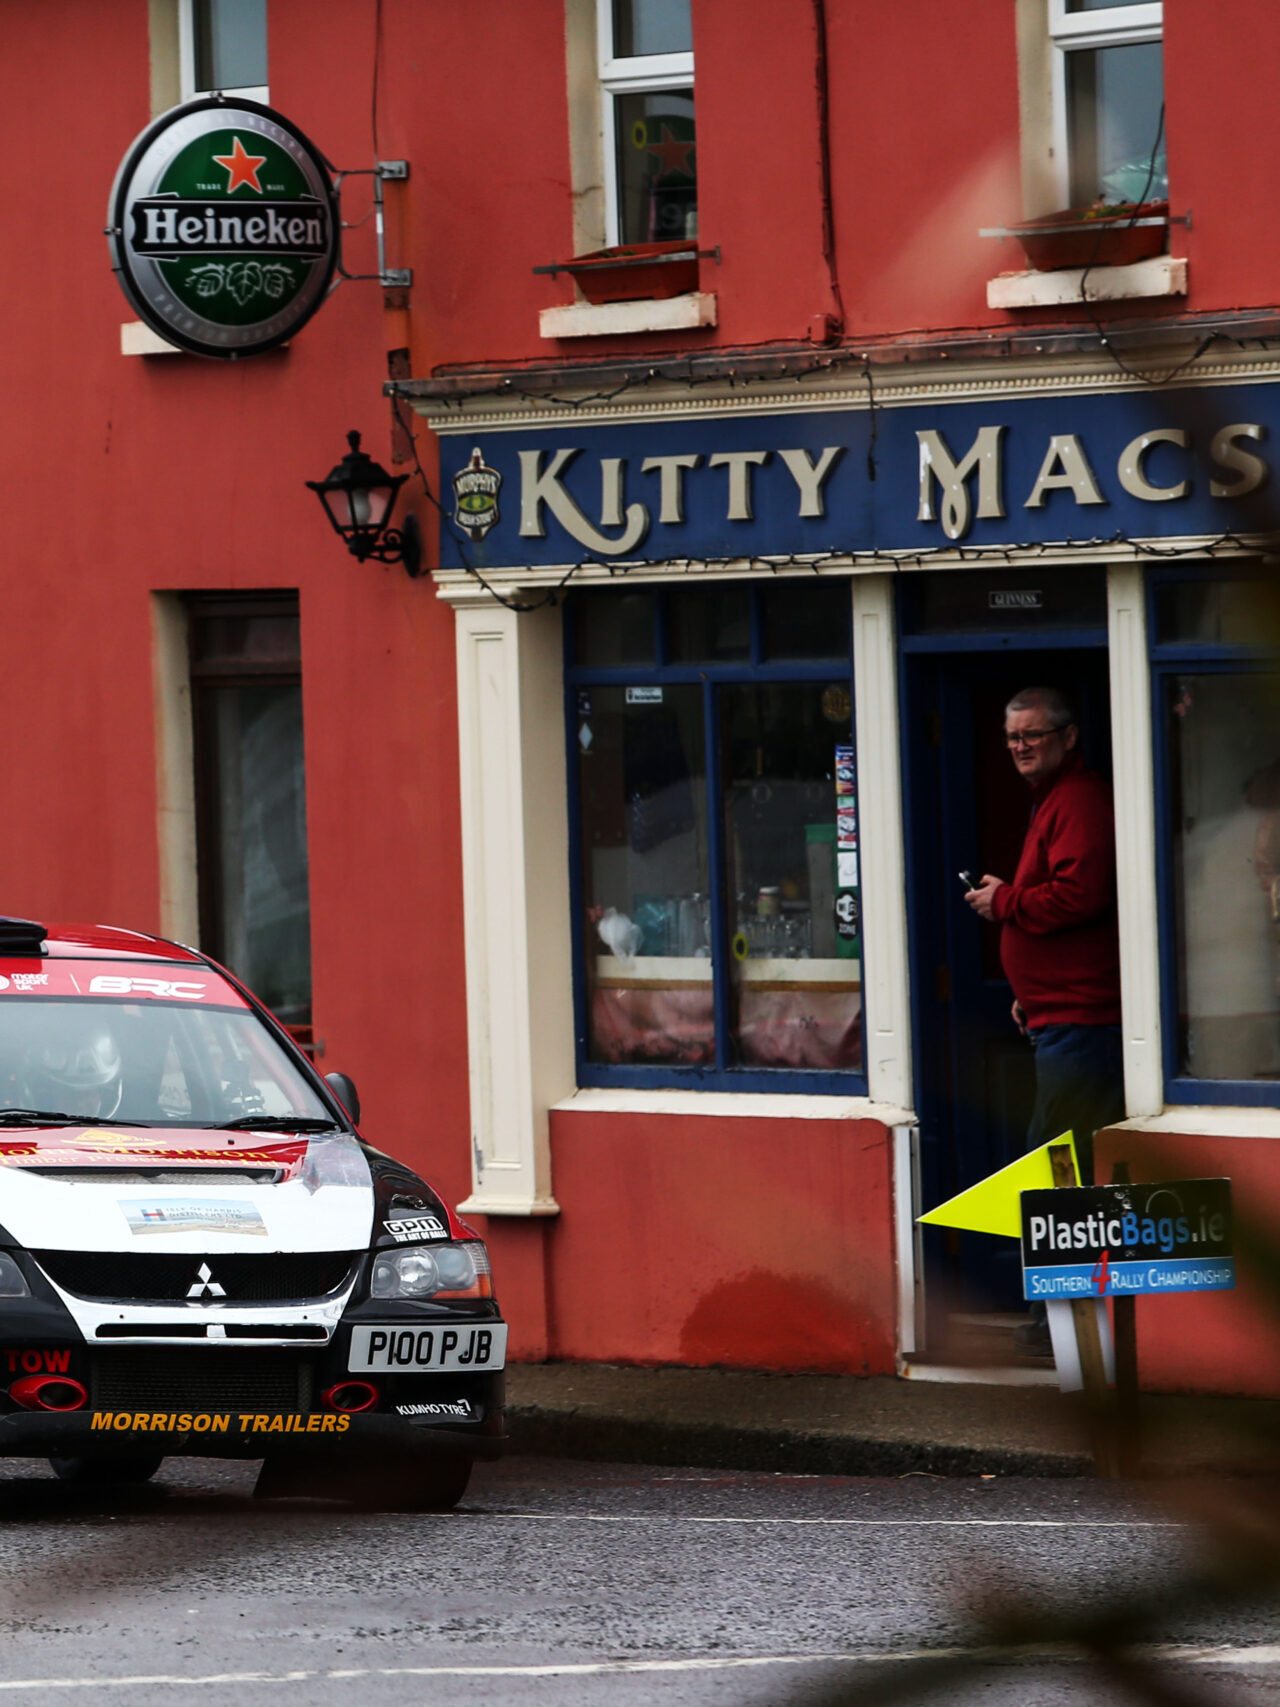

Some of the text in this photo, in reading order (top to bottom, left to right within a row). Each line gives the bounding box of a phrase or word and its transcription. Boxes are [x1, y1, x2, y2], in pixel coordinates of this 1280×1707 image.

[143, 208, 323, 244] Heineken
[518, 424, 1268, 555] KITTY MACS
[994, 593, 1037, 605] GUINNESS
[89, 976, 206, 999] BRC
[94, 1147, 269, 1159] Morrison
[1030, 1206, 1224, 1253] PlasticBags.ie
[1032, 1274, 1092, 1294] SOUTHERN
[1111, 1270, 1144, 1289] RALLY
[1148, 1268, 1232, 1287] CHAMPIONSHIP
[367, 1330, 492, 1365] P100 PJB
[6, 1349, 72, 1373] TOW
[396, 1404, 468, 1416] KUMHO TYRE
[90, 1412, 351, 1433] MORRISON TRAILERS
